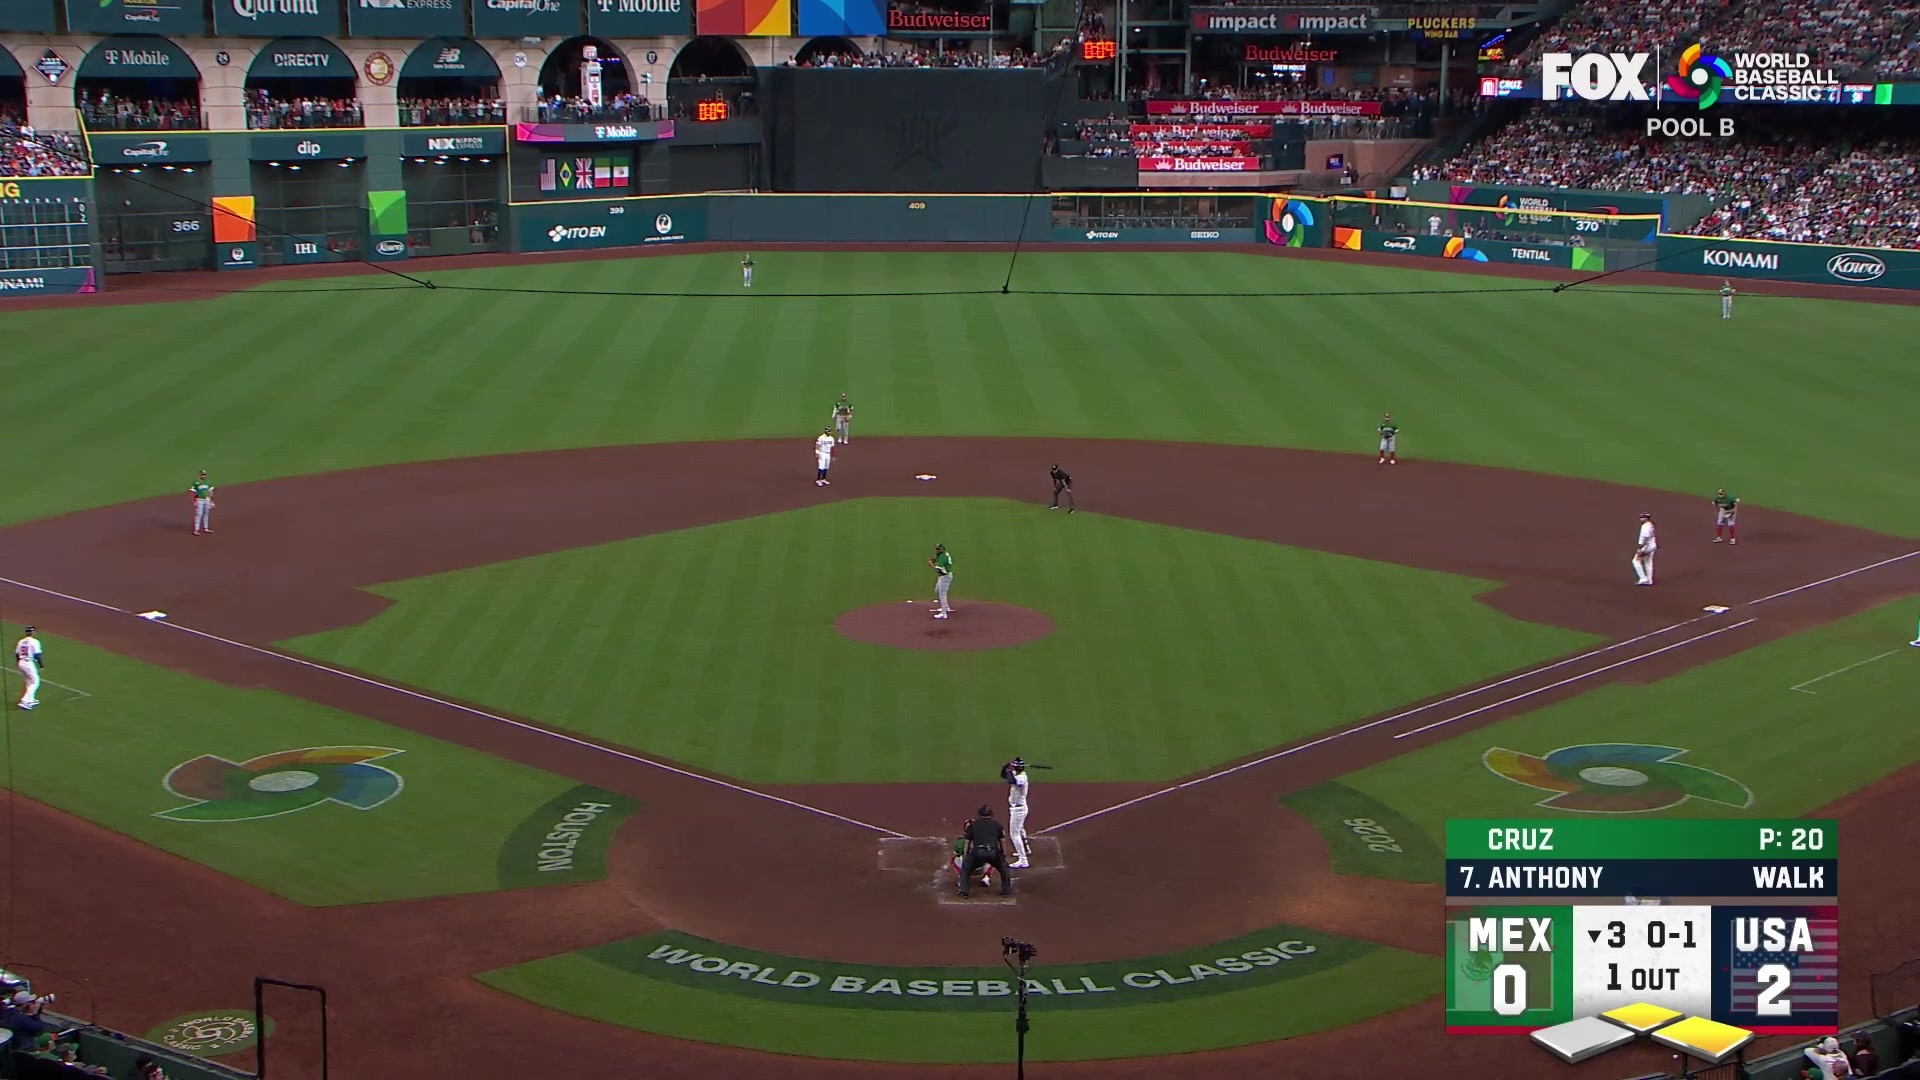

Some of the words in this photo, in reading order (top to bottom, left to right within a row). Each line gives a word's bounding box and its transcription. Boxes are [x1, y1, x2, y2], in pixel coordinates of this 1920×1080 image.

[889, 10, 991, 28] Budweiser
[1209, 13, 1277, 30] impact
[1299, 13, 1367, 30] impact
[1407, 17, 1476, 29] PLUCKERS
[122, 50, 169, 65] Mobile
[1245, 45, 1338, 61] Budweiser
[274, 54, 329, 66] DIRECTV
[1189, 102, 1259, 114] Budweiser
[1300, 102, 1362, 115] Budweiser
[606, 126, 638, 138] Mobile
[297, 141, 321, 156] dip
[1174, 158, 1245, 170] Budweiser
[908, 202, 926, 210] 409
[1520, 197, 1549, 207] WORLD
[609, 206, 624, 214] 399
[173, 221, 199, 232] 366
[567, 227, 588, 239] ITO
[589, 226, 607, 238] EN
[1576, 221, 1599, 232] 370
[1191, 231, 1220, 239] SEIKO
[294, 243, 318, 255] IHI
[1511, 247, 1551, 261] TENTIAL
[1703, 249, 1778, 270] KONAMI
[1830, 256, 1883, 275] Kowa
[537, 801, 613, 872] HOUSTON
[1343, 817, 1403, 853] 2026
[646, 944, 821, 988] WORLD
[829, 974, 1116, 996] BASEBALL
[1122, 939, 1317, 989] CLASSIC
